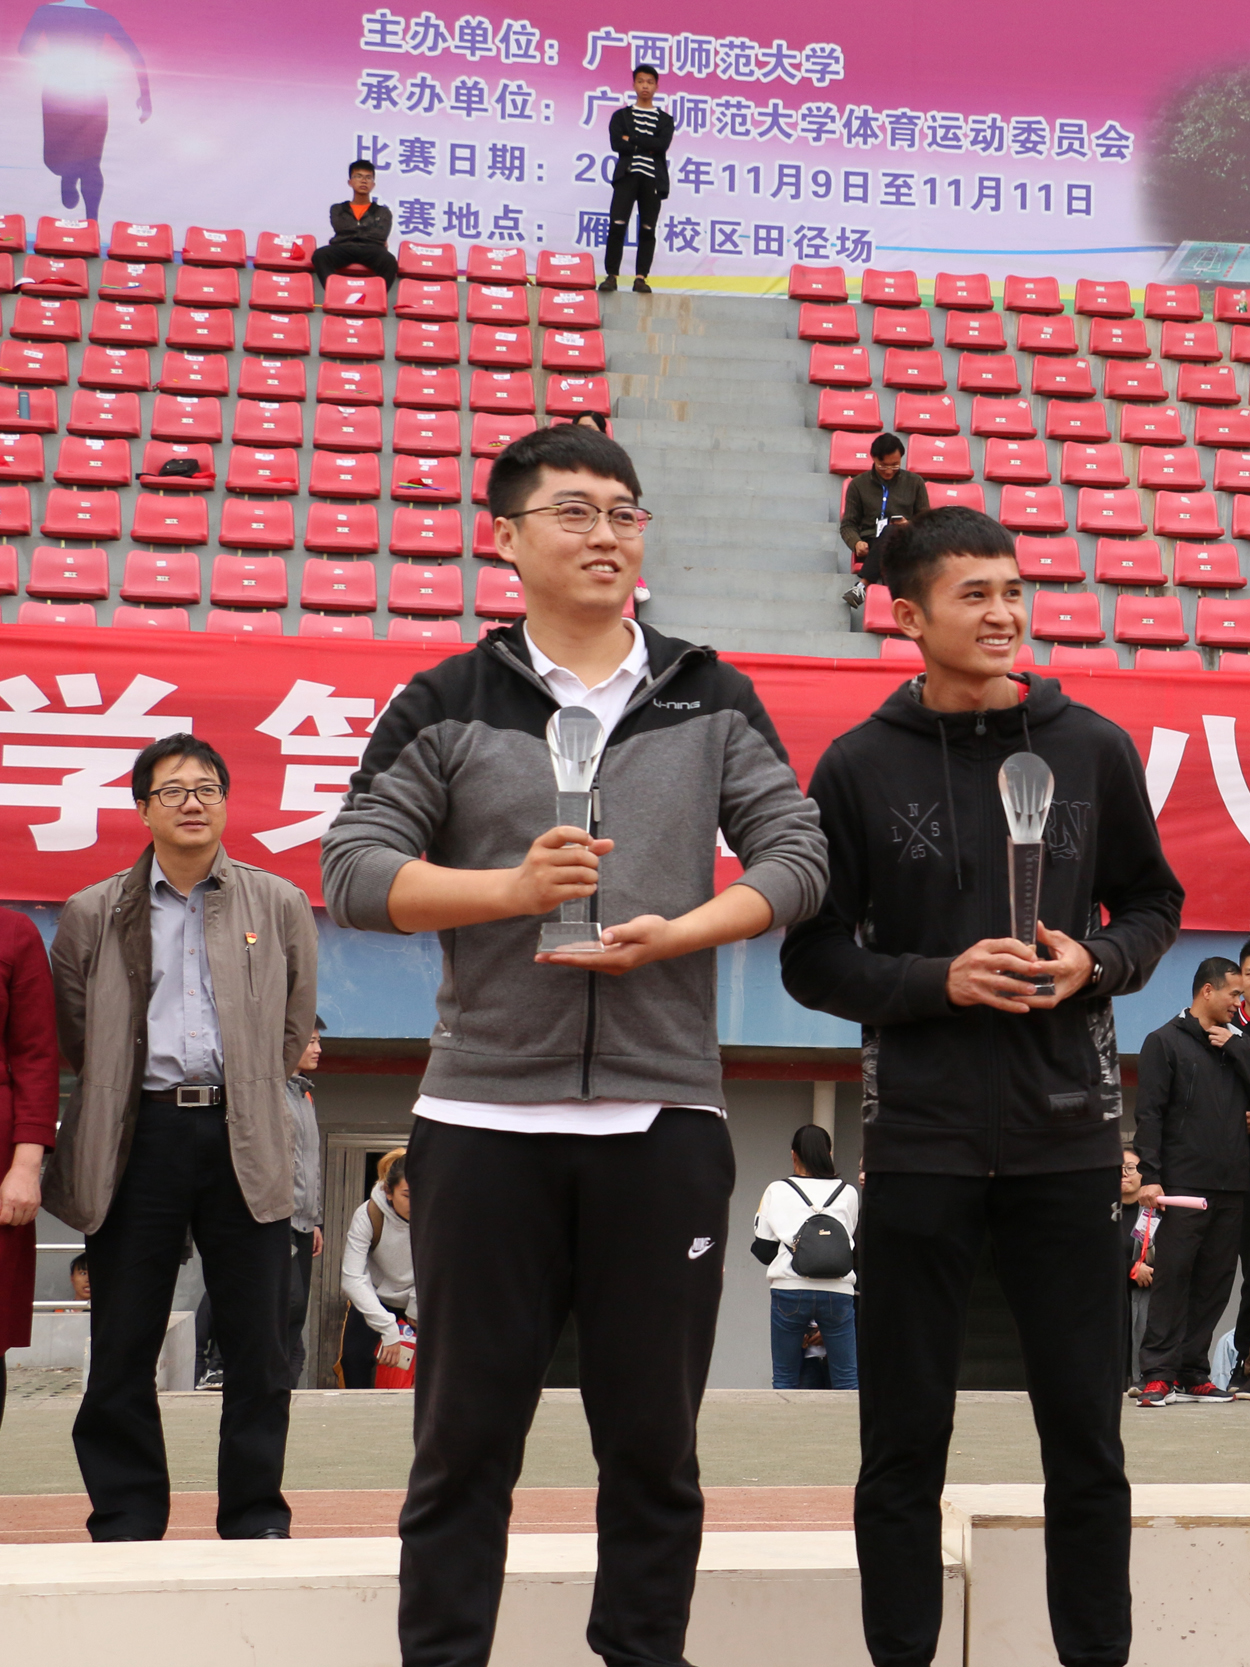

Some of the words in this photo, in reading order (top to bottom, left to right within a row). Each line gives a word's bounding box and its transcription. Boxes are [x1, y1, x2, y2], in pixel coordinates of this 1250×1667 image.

[358, 71, 1133, 161] 承办单位：广师范大学体育运动委员会
[355, 134, 1093, 218] 比赛日期：20年11月9日至11月11日
